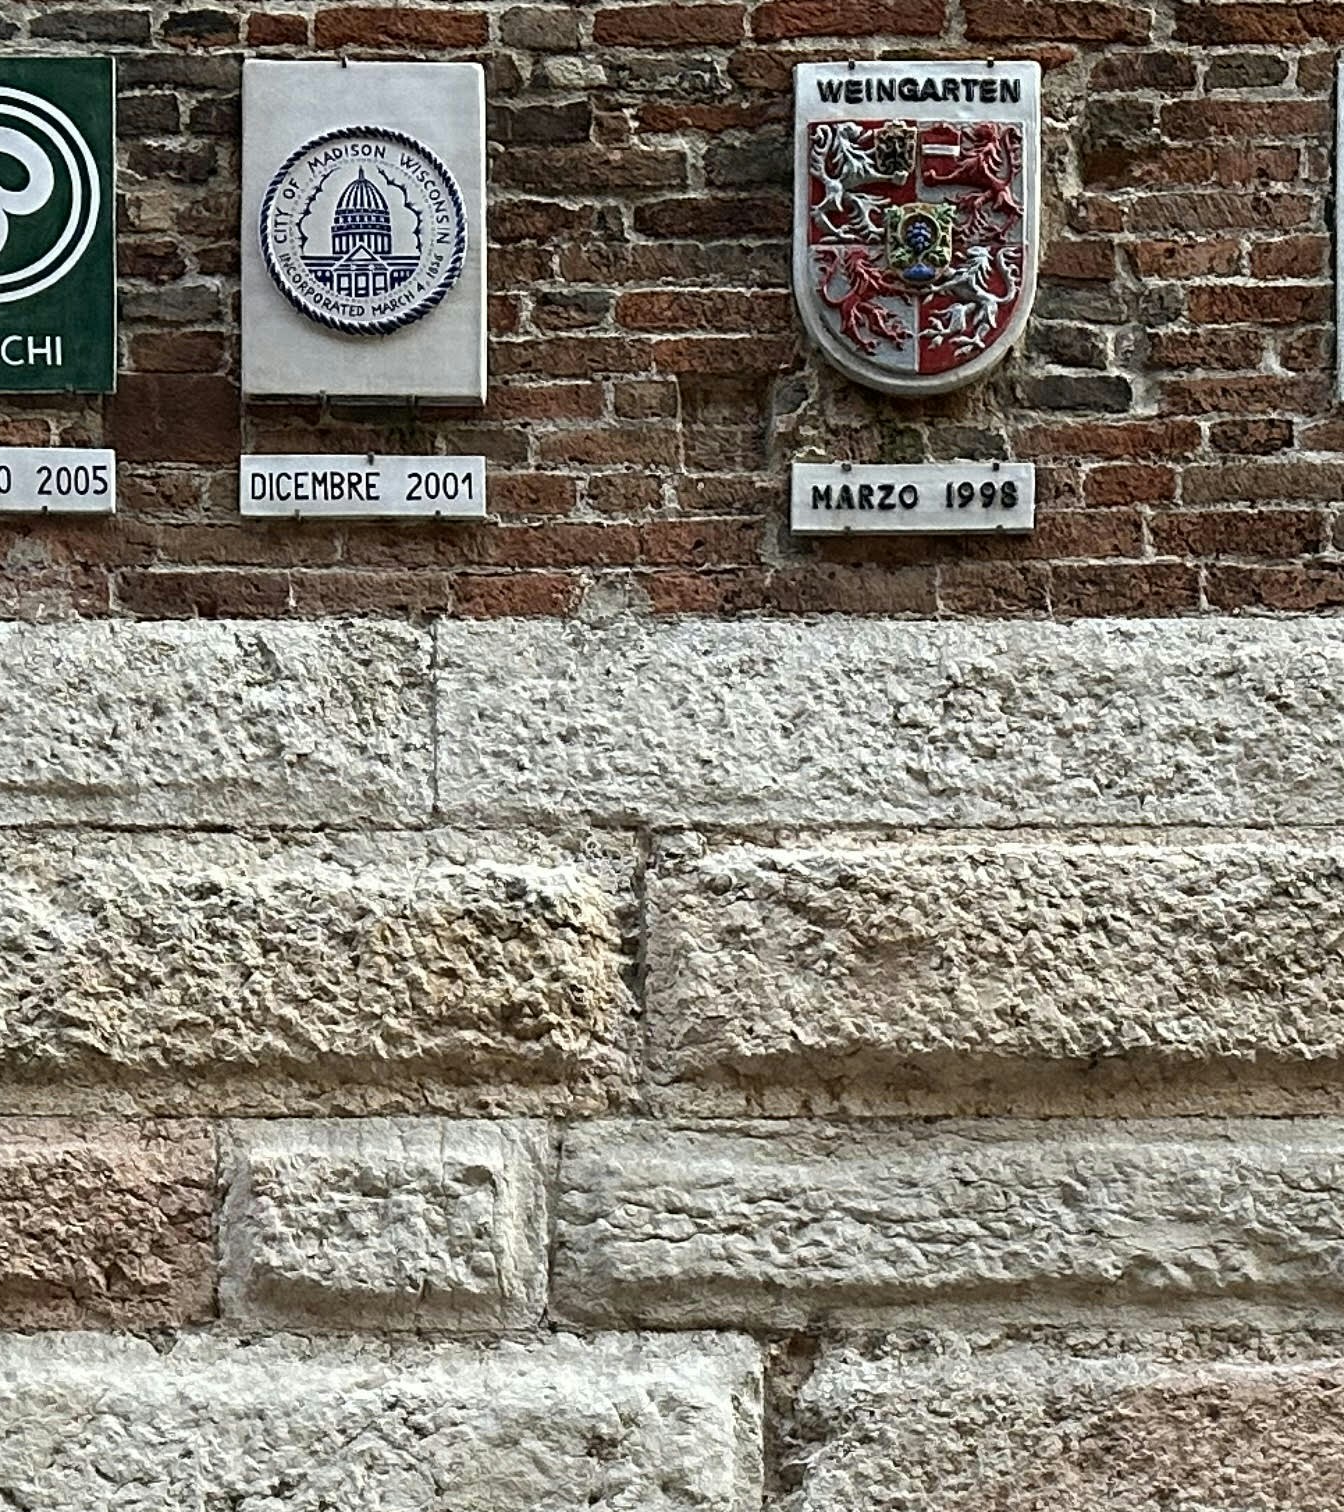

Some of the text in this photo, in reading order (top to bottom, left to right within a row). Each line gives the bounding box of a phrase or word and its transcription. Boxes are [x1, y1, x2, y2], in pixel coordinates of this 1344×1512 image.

[816, 77, 1022, 105] WEINGARTEN
[273, 144, 451, 245] CITY OF MADISON WISCONSIN
[278, 252, 365, 317] INCORPORATED
[371, 292, 416, 316] MARCH
[415, 281, 425, 292] 4
[36, 464, 109, 497] 2005
[250, 470, 474, 502] DICEMBRE 2001
[811, 480, 1020, 511] MARZO 1998
